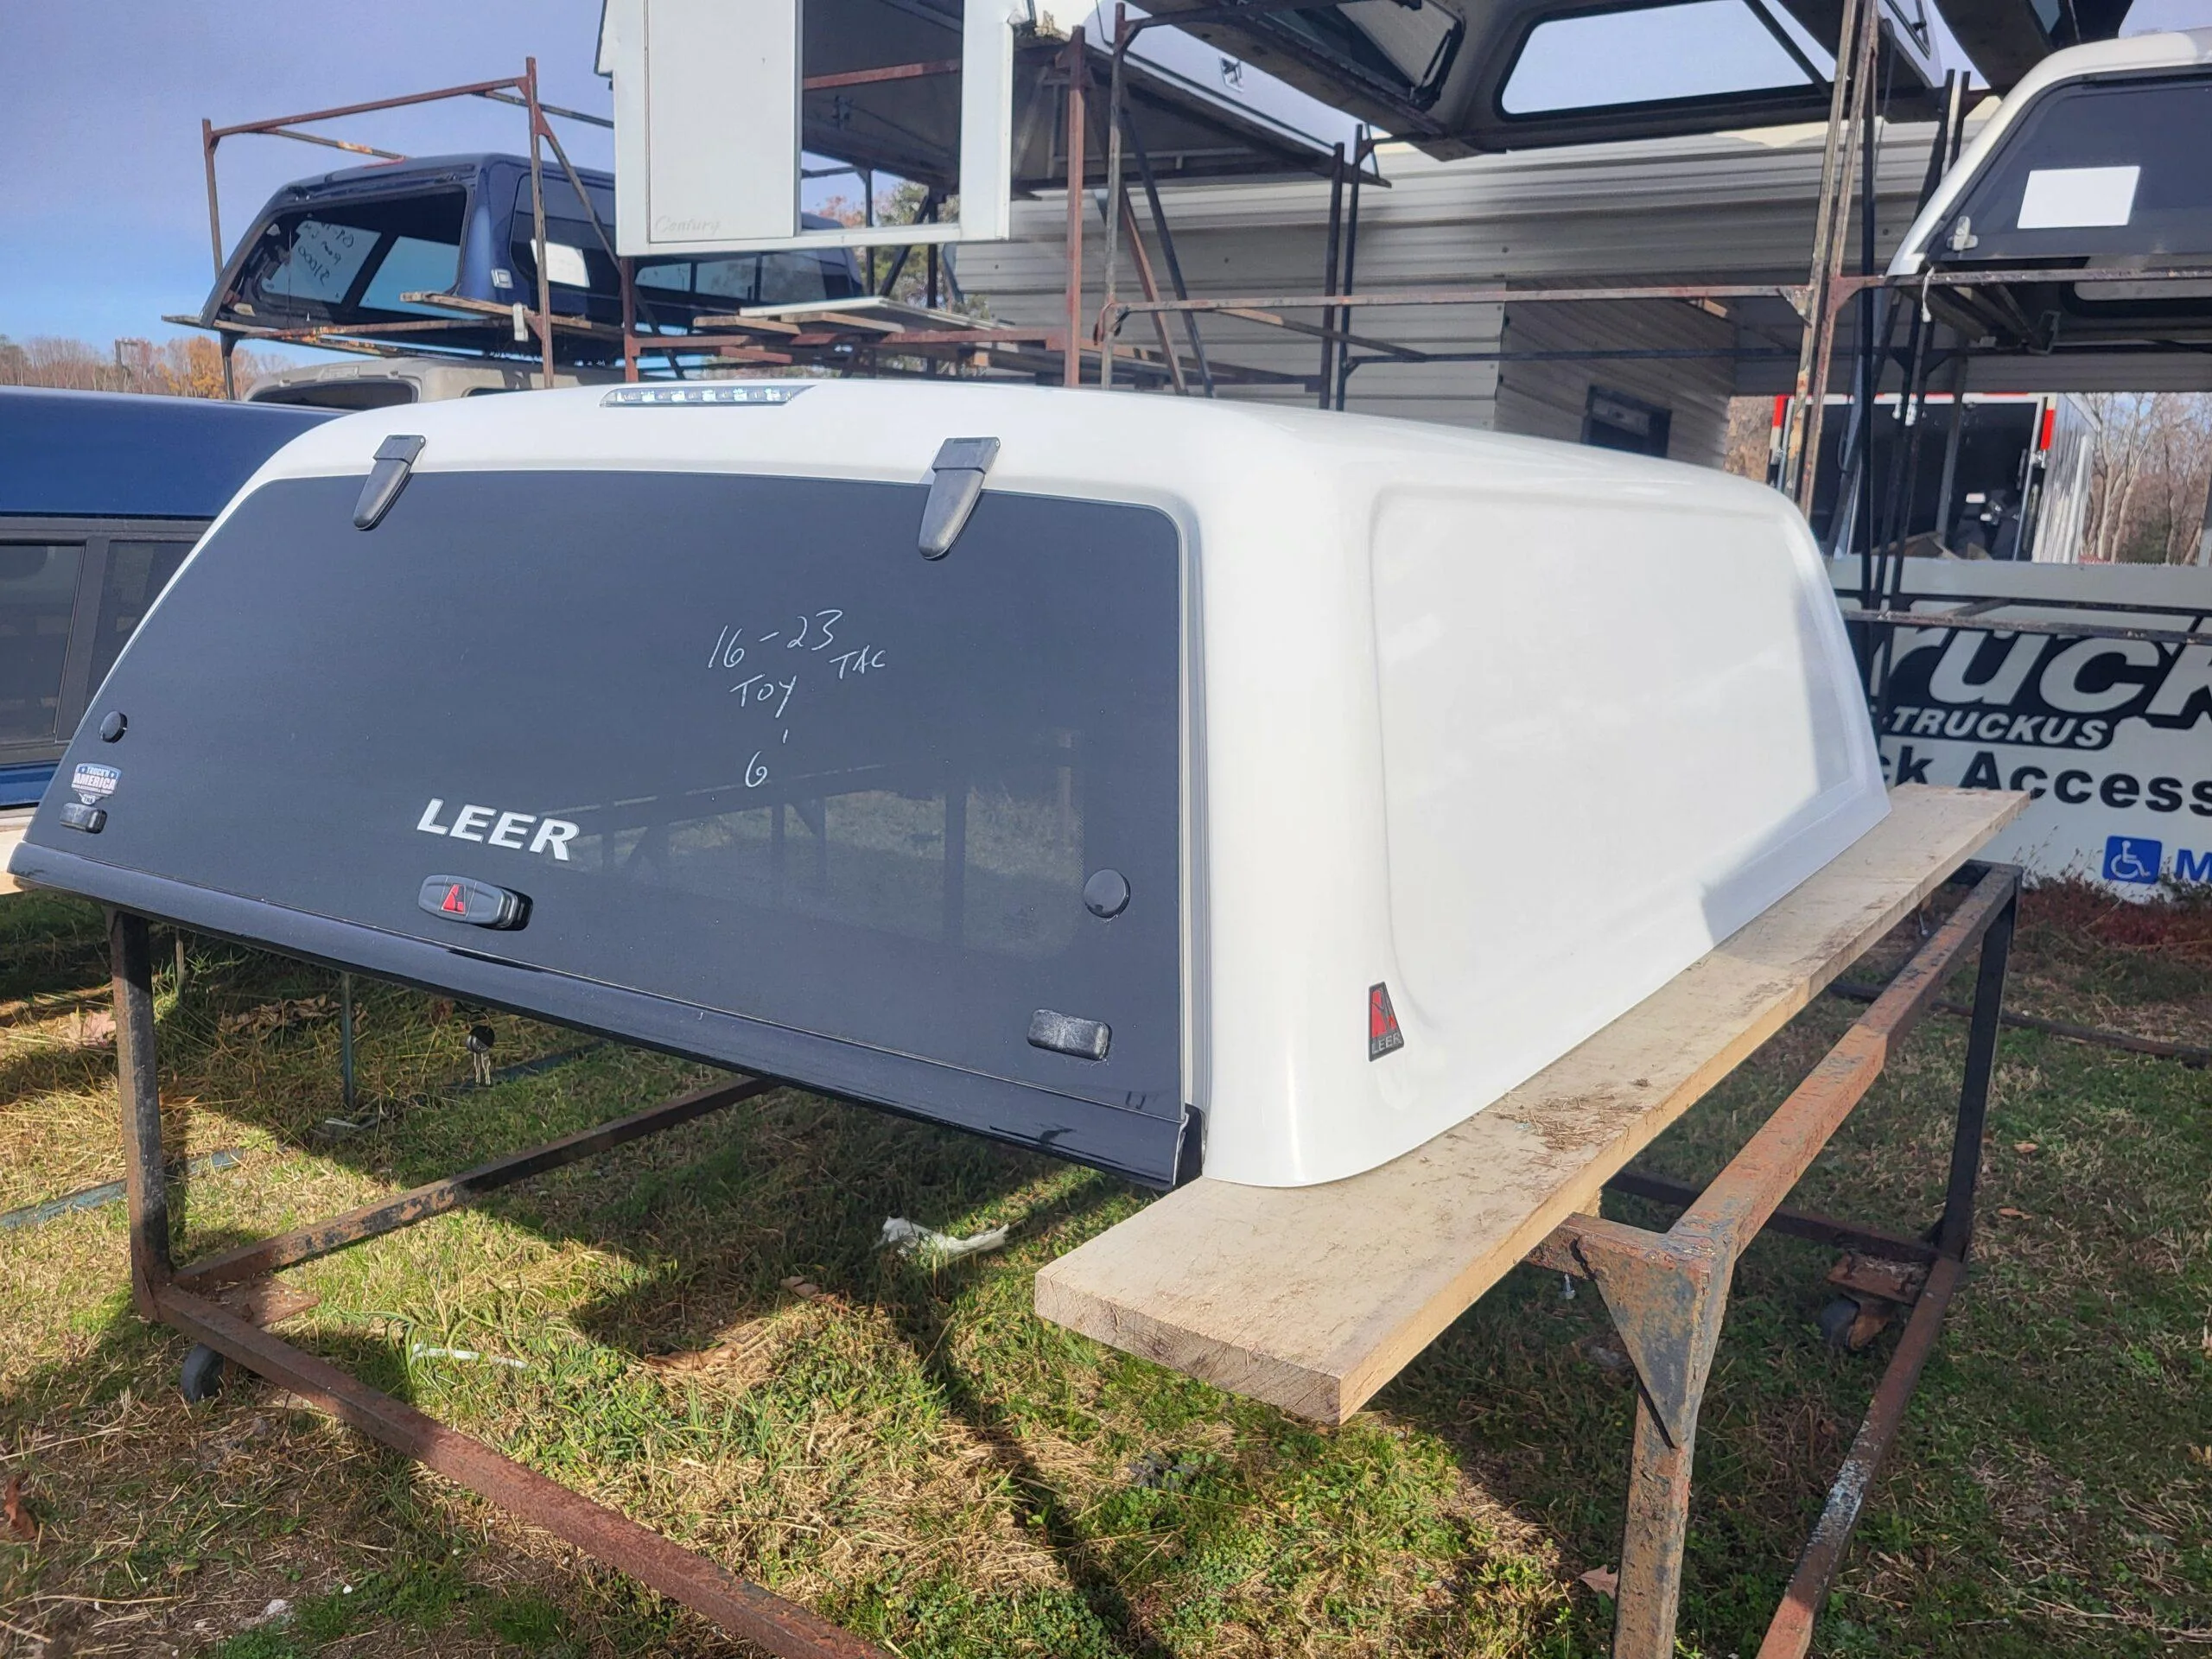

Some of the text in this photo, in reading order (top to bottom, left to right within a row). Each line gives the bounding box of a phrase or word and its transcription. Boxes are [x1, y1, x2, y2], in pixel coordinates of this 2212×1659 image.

[655, 215, 722, 236] Century
[1891, 705, 2109, 748] TRUCKUS
[73, 772, 117, 791] AMERICA
[416, 798, 580, 861] LEER
[1371, 1032, 1402, 1054] LEER
